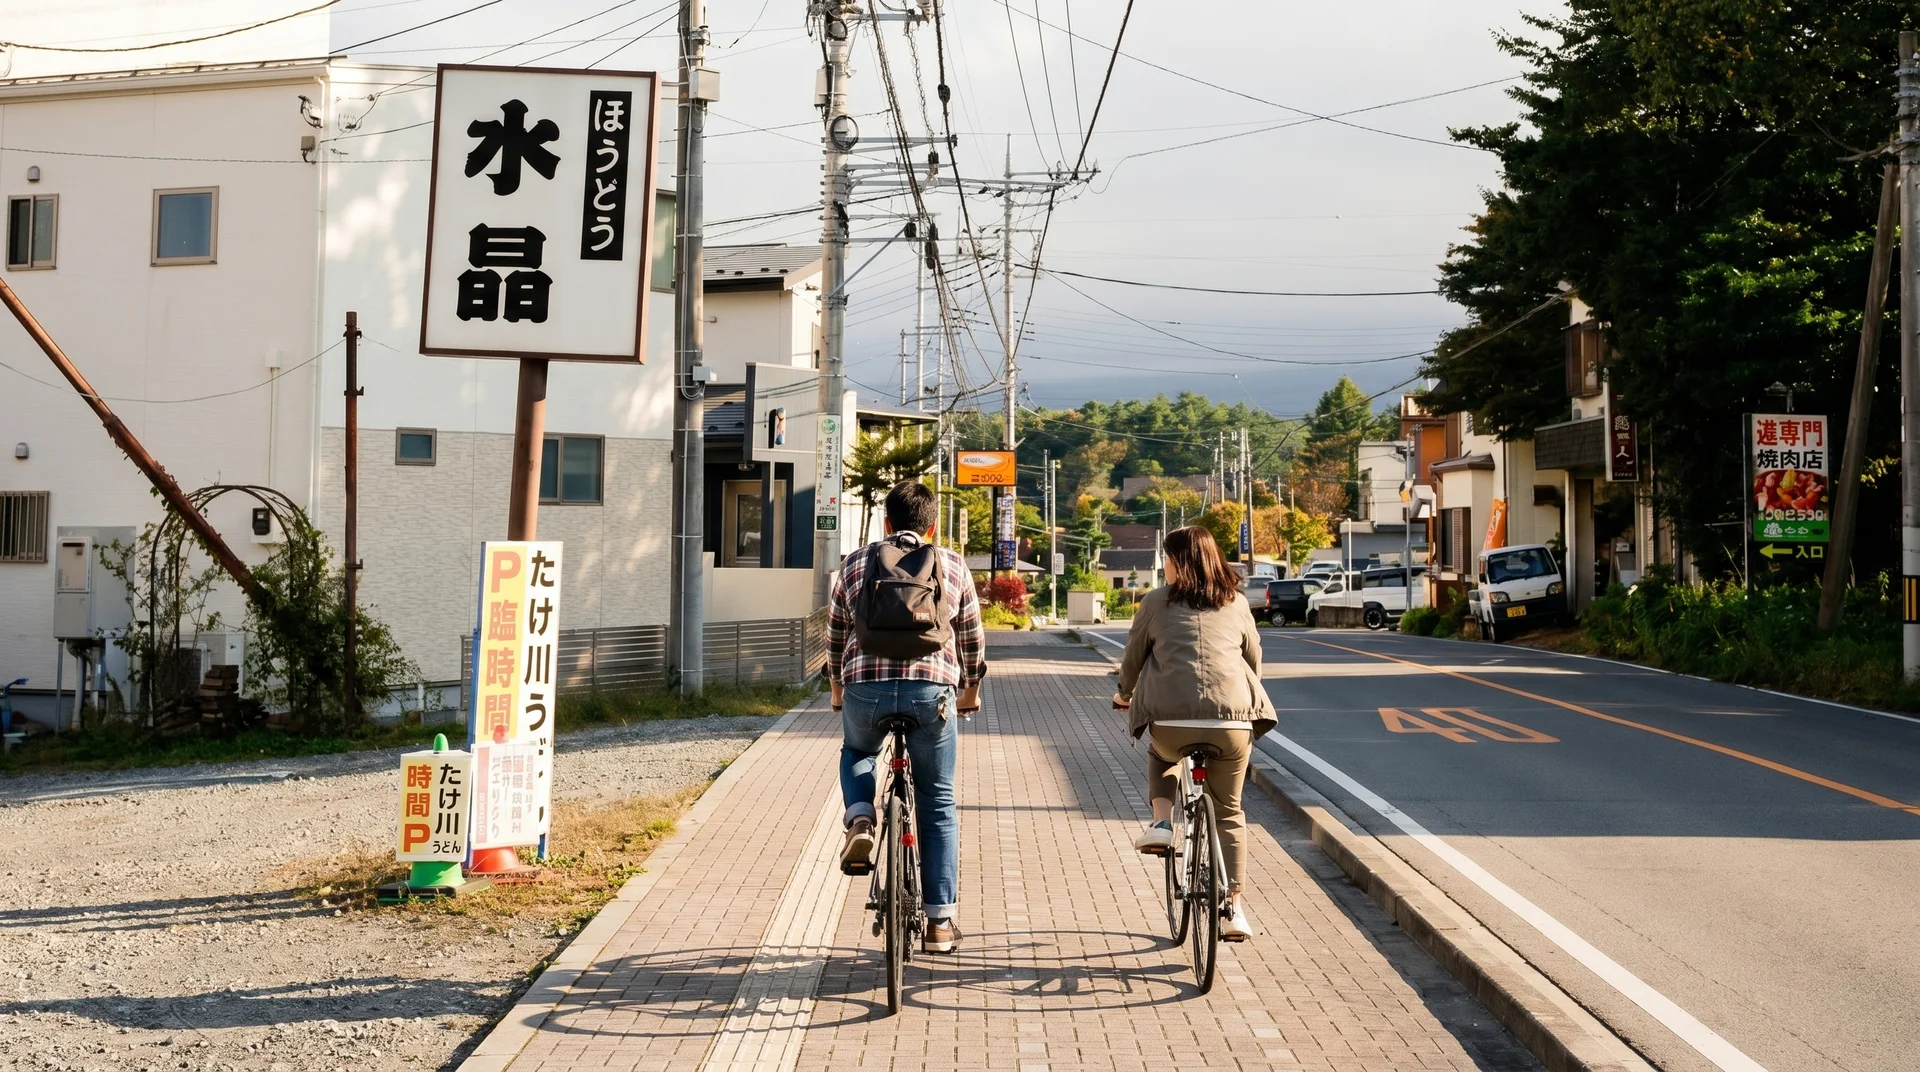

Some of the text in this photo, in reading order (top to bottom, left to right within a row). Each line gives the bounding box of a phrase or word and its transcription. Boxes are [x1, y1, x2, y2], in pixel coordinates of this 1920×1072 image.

[456, 98, 561, 323] 水晶
[591, 98, 624, 252] ほうどう
[1757, 449, 1823, 469] 焼肉店
[1796, 545, 1823, 558] 入口
[524, 550, 556, 822] たけ川う
[1378, 707, 1561, 743] 40
[403, 765, 432, 853] 時間P
[434, 763, 462, 835] たけ川
[432, 840, 461, 854] うどん
